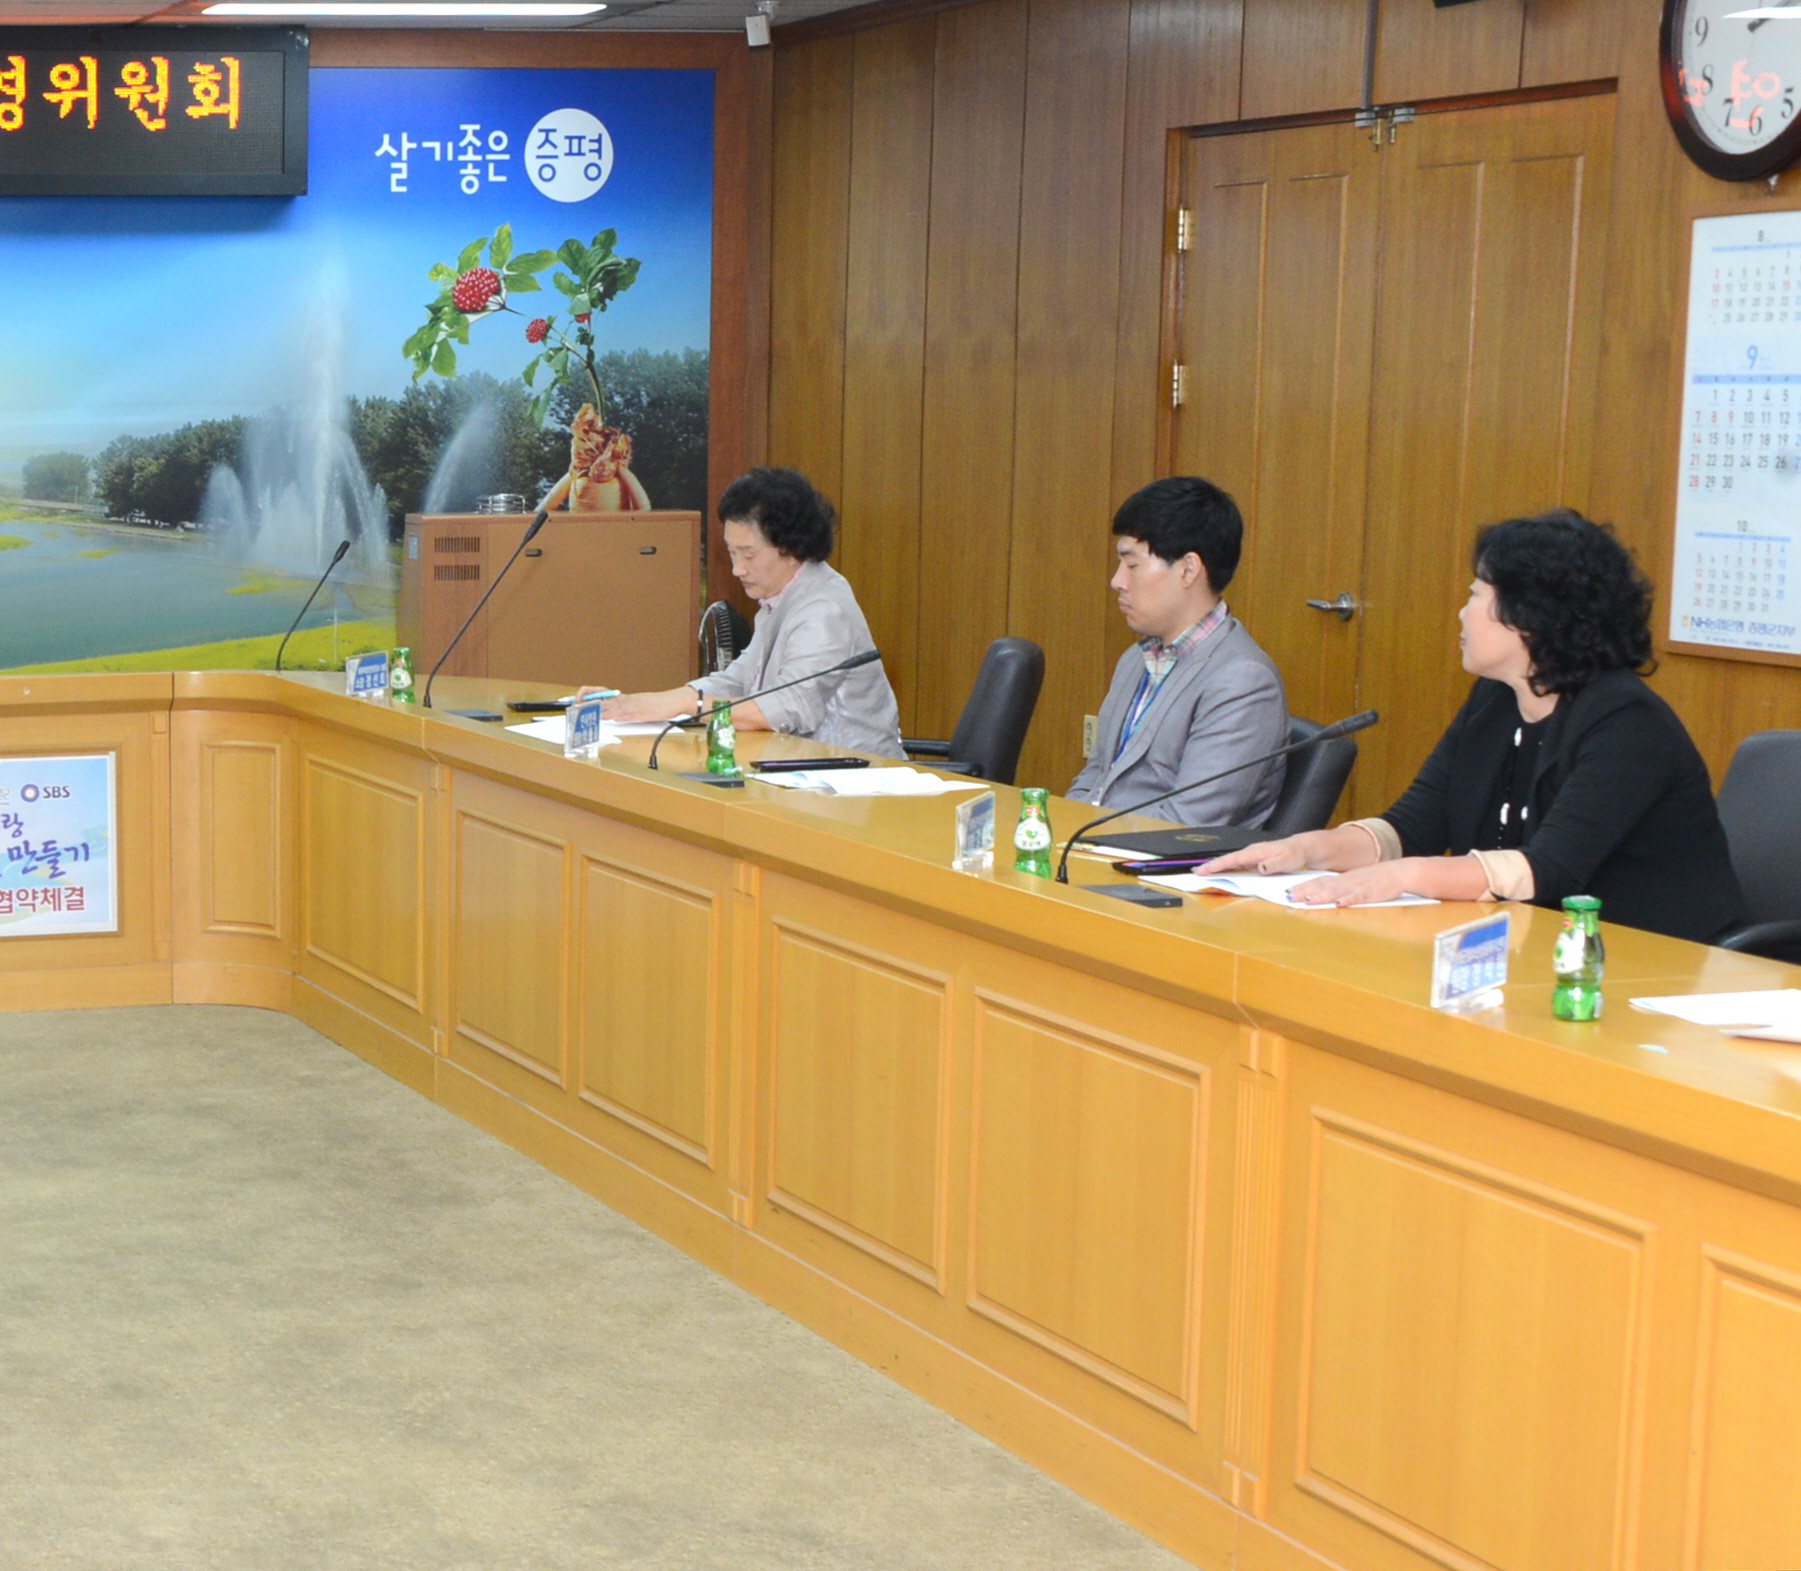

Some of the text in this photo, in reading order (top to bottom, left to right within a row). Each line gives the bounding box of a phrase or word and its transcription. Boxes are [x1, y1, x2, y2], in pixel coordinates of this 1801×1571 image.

[1695, 16, 1709, 48] 9
[1702, 64, 1714, 96] 8
[1722, 97, 1734, 127] 7
[1781, 87, 1794, 119] 5
[1749, 105, 1762, 136] 6
[374, 124, 603, 195] 살기좋은 증평
[1747, 345, 1757, 370] 9
[1737, 520, 1748, 532] 10
[43, 786, 70, 799] SBS
[7, 839, 90, 880] 만들기
